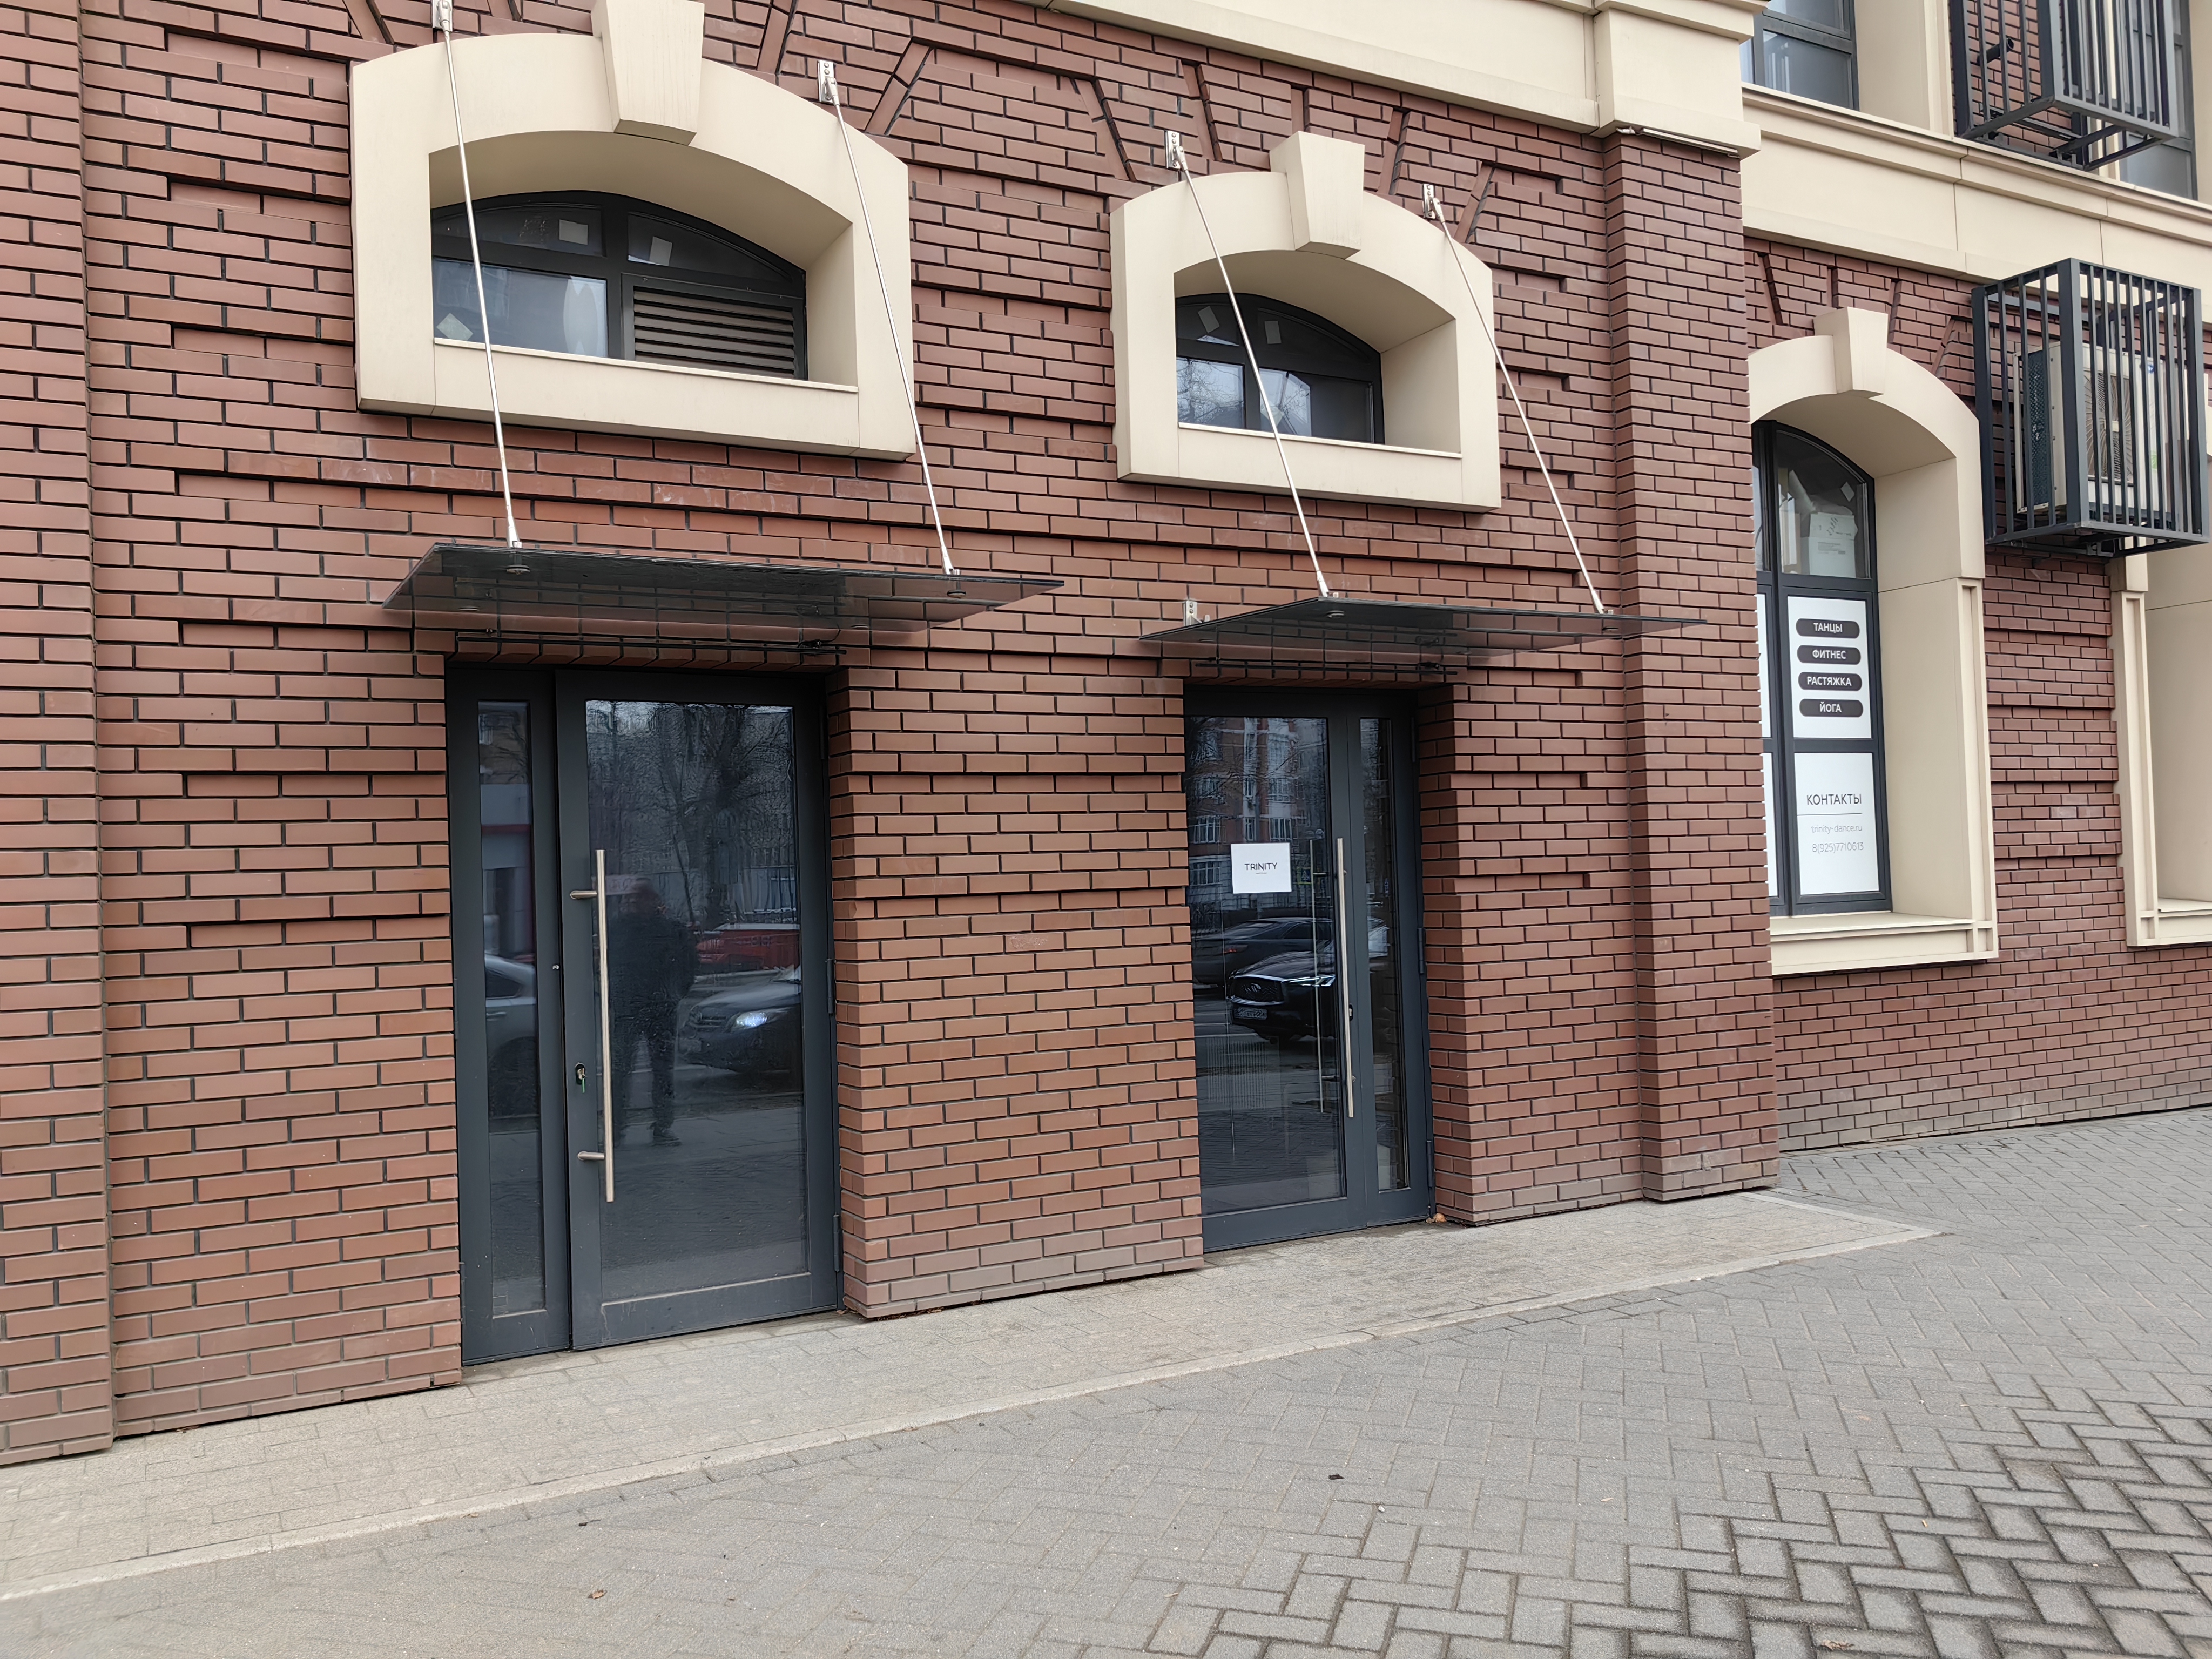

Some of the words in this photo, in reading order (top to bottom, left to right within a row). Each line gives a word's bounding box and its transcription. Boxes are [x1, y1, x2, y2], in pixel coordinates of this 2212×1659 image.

[1813, 622, 1843, 633] ТАНЦЫ
[1812, 649, 1846, 659] ФИТНЕС
[1807, 676, 1852, 686] РАСТЯЖКА
[1819, 701, 1842, 712] ЙОГА
[1806, 794, 1862, 805] КОНТАКТЫ
[1811, 824, 1863, 834] trinity-dance.ru
[1812, 842, 1864, 854] 8(925)7710613
[1244, 862, 1277, 871] TRINITY
